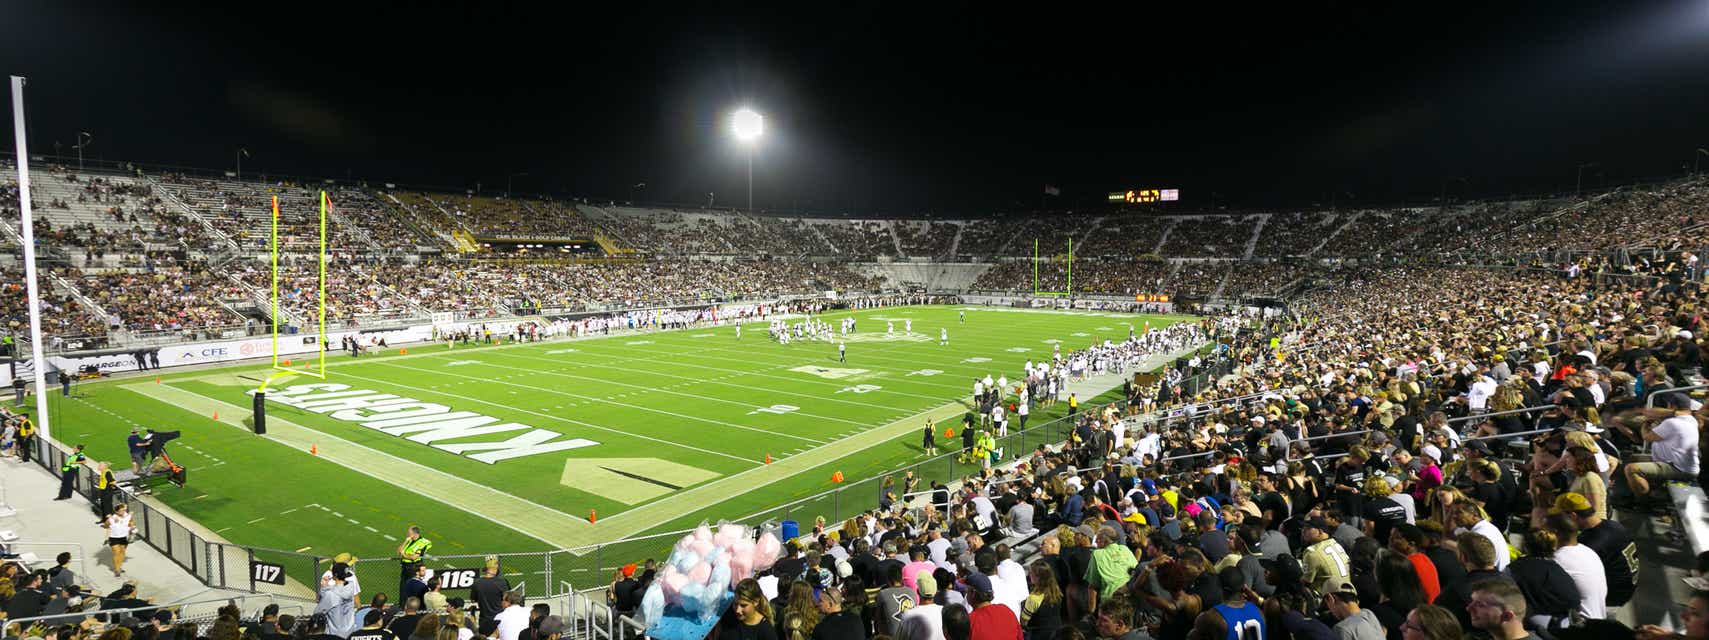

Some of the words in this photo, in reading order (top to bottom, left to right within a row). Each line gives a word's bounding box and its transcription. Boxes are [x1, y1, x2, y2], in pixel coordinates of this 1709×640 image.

[202, 347, 227, 357] CFE
[255, 564, 280, 581] 117
[441, 570, 475, 588] 116
